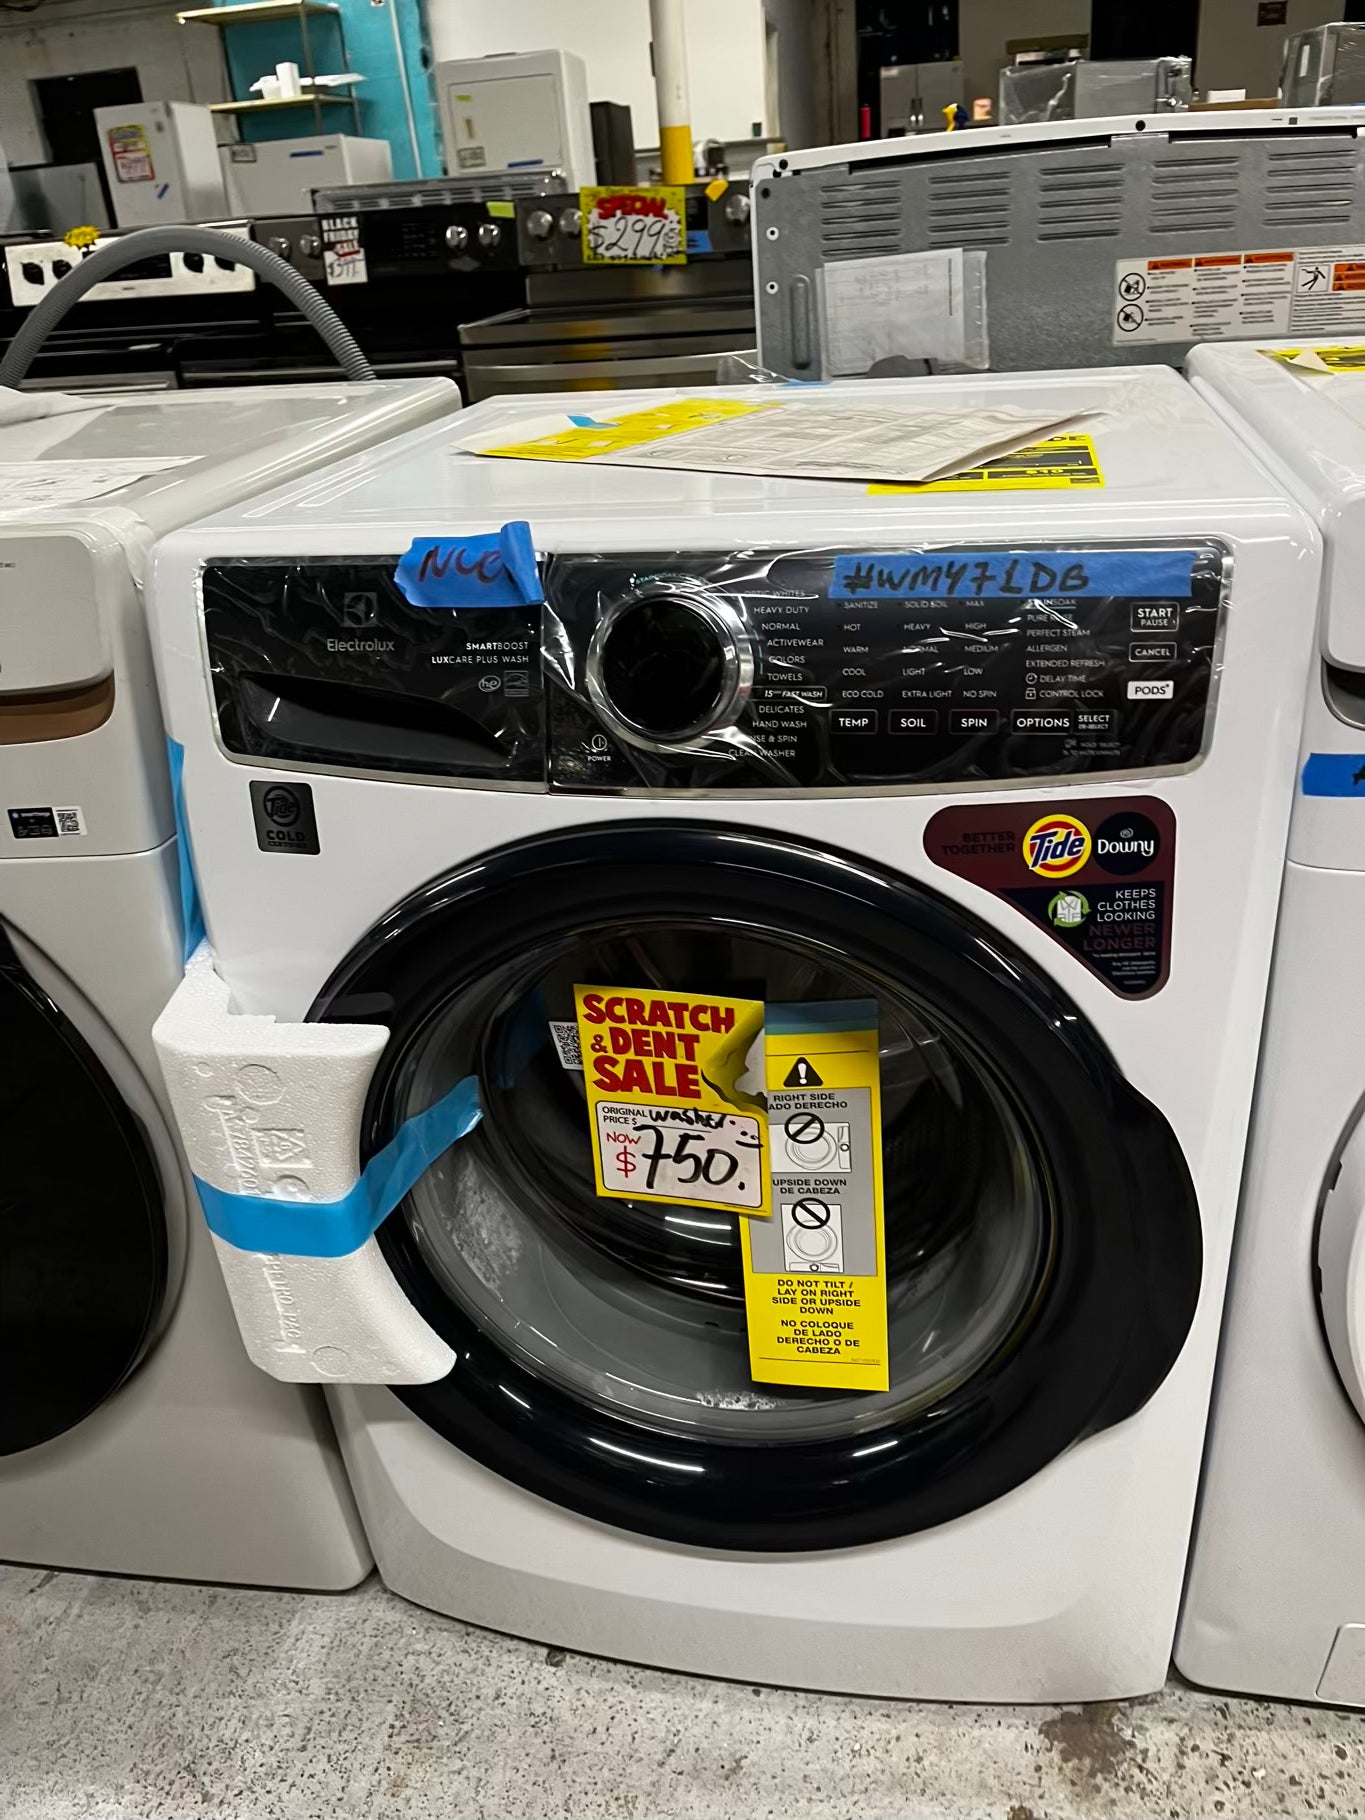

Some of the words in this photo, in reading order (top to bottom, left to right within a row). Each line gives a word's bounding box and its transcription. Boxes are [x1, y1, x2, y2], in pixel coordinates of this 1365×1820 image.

[844, 601, 879, 609] SANITIZE
[904, 601, 929, 609] SOLID
[753, 606, 782, 615] HEAVY
[785, 606, 809, 614] DUTY
[1137, 608, 1173, 618] START
[1027, 614, 1048, 622] PURE
[1140, 618, 1168, 626] PAUSE
[761, 622, 801, 631] NORMAL
[843, 623, 861, 631] HOT
[903, 623, 931, 631] HEAVY
[965, 622, 987, 630] HIGH
[1026, 629, 1060, 637] PERFECT
[1062, 629, 1091, 637] STEAM
[326, 638, 396, 652] Electrolux
[465, 641, 529, 651] SMARTBOOST
[766, 638, 824, 647] ACTIVEWEAR
[1026, 644, 1068, 652] ALLERGEN
[1134, 648, 1171, 656] CANCEL
[431, 655, 473, 664] LUXCARE
[476, 655, 499, 664] PLUS
[501, 655, 529, 663] WASH
[768, 655, 806, 664] COLORS
[1025, 659, 1069, 668] EXTENDED
[1070, 659, 1105, 668] REFRESH
[842, 668, 867, 676] COOL
[902, 668, 926, 676] LIGHT
[963, 667, 984, 675] LOW
[767, 673, 803, 682] TOWELS
[1039, 675, 1065, 683] DELAY
[1067, 675, 1087, 683] TIME
[842, 690, 860, 698] ECO
[861, 690, 884, 698] COLD
[902, 690, 928, 698] EXTRA
[929, 690, 952, 698] LIGHT
[963, 690, 977, 698] NO
[978, 690, 998, 698] SPIN
[1039, 690, 1079, 698] CONTROL
[1081, 690, 1104, 698] LOCK
[758, 705, 805, 714] DELICATES
[838, 718, 869, 728] TEMP
[900, 718, 927, 728] SOIL
[960, 718, 988, 728] SPIN
[1016, 717, 1070, 728] OPTIONS
[1078, 714, 1110, 723] SELECT
[752, 720, 778, 728] HAND
[781, 720, 807, 728] WASH
[728, 748, 755, 757] CLEA
[759, 749, 796, 757] WASHER
[266, 829, 306, 842] COLD
[962, 830, 1015, 843] BETTER
[941, 843, 1016, 855] TOGETHER
[1028, 828, 1086, 870] Tide
[1097, 837, 1155, 857] Downy
[1115, 888, 1156, 899] KEEPS
[1097, 899, 1156, 911] CLOTHES
[1096, 910, 1156, 922] LOOKING
[1089, 923, 1156, 937] NEWER
[1084, 936, 1156, 951] LONGER
[582, 993, 735, 1034] SCRATCH
[590, 1033, 608, 1054] &
[608, 1026, 700, 1062] DENT
[592, 1055, 702, 1100] SALE
[773, 1094, 806, 1102] RIGHT
[809, 1093, 835, 1101] SIDE
[768, 1102, 792, 1110] ADO
[794, 1101, 848, 1110] DERECHO
[602, 1105, 648, 1118] ORIGINAL
[603, 1115, 628, 1125] PRICE
[629, 1117, 637, 1126] $
[606, 1131, 642, 1145] NOW
[772, 1178, 811, 1187] UPSIDE
[814, 1178, 847, 1187] DOWN
[797, 1187, 841, 1195] CABEZA
[777, 1279, 794, 1287] DO
[797, 1280, 820, 1288] NOT
[823, 1281, 846, 1289] TILT
[777, 1288, 797, 1296] LAY
[820, 1289, 854, 1298] RIGHT
[772, 1296, 797, 1305] SIDE
[801, 1297, 817, 1305] OR
[820, 1298, 861, 1307] UPSIDE
[799, 1306, 834, 1315] DOWN
[781, 1319, 797, 1328] NO
[800, 1320, 854, 1330] COLOQUE
[793, 1329, 809, 1337] DE
[812, 1329, 842, 1338] LADO
[776, 1336, 830, 1346] DERECHO
[833, 1338, 841, 1346] O
[845, 1339, 860, 1347] DE
[796, 1346, 841, 1355] CABEZA
